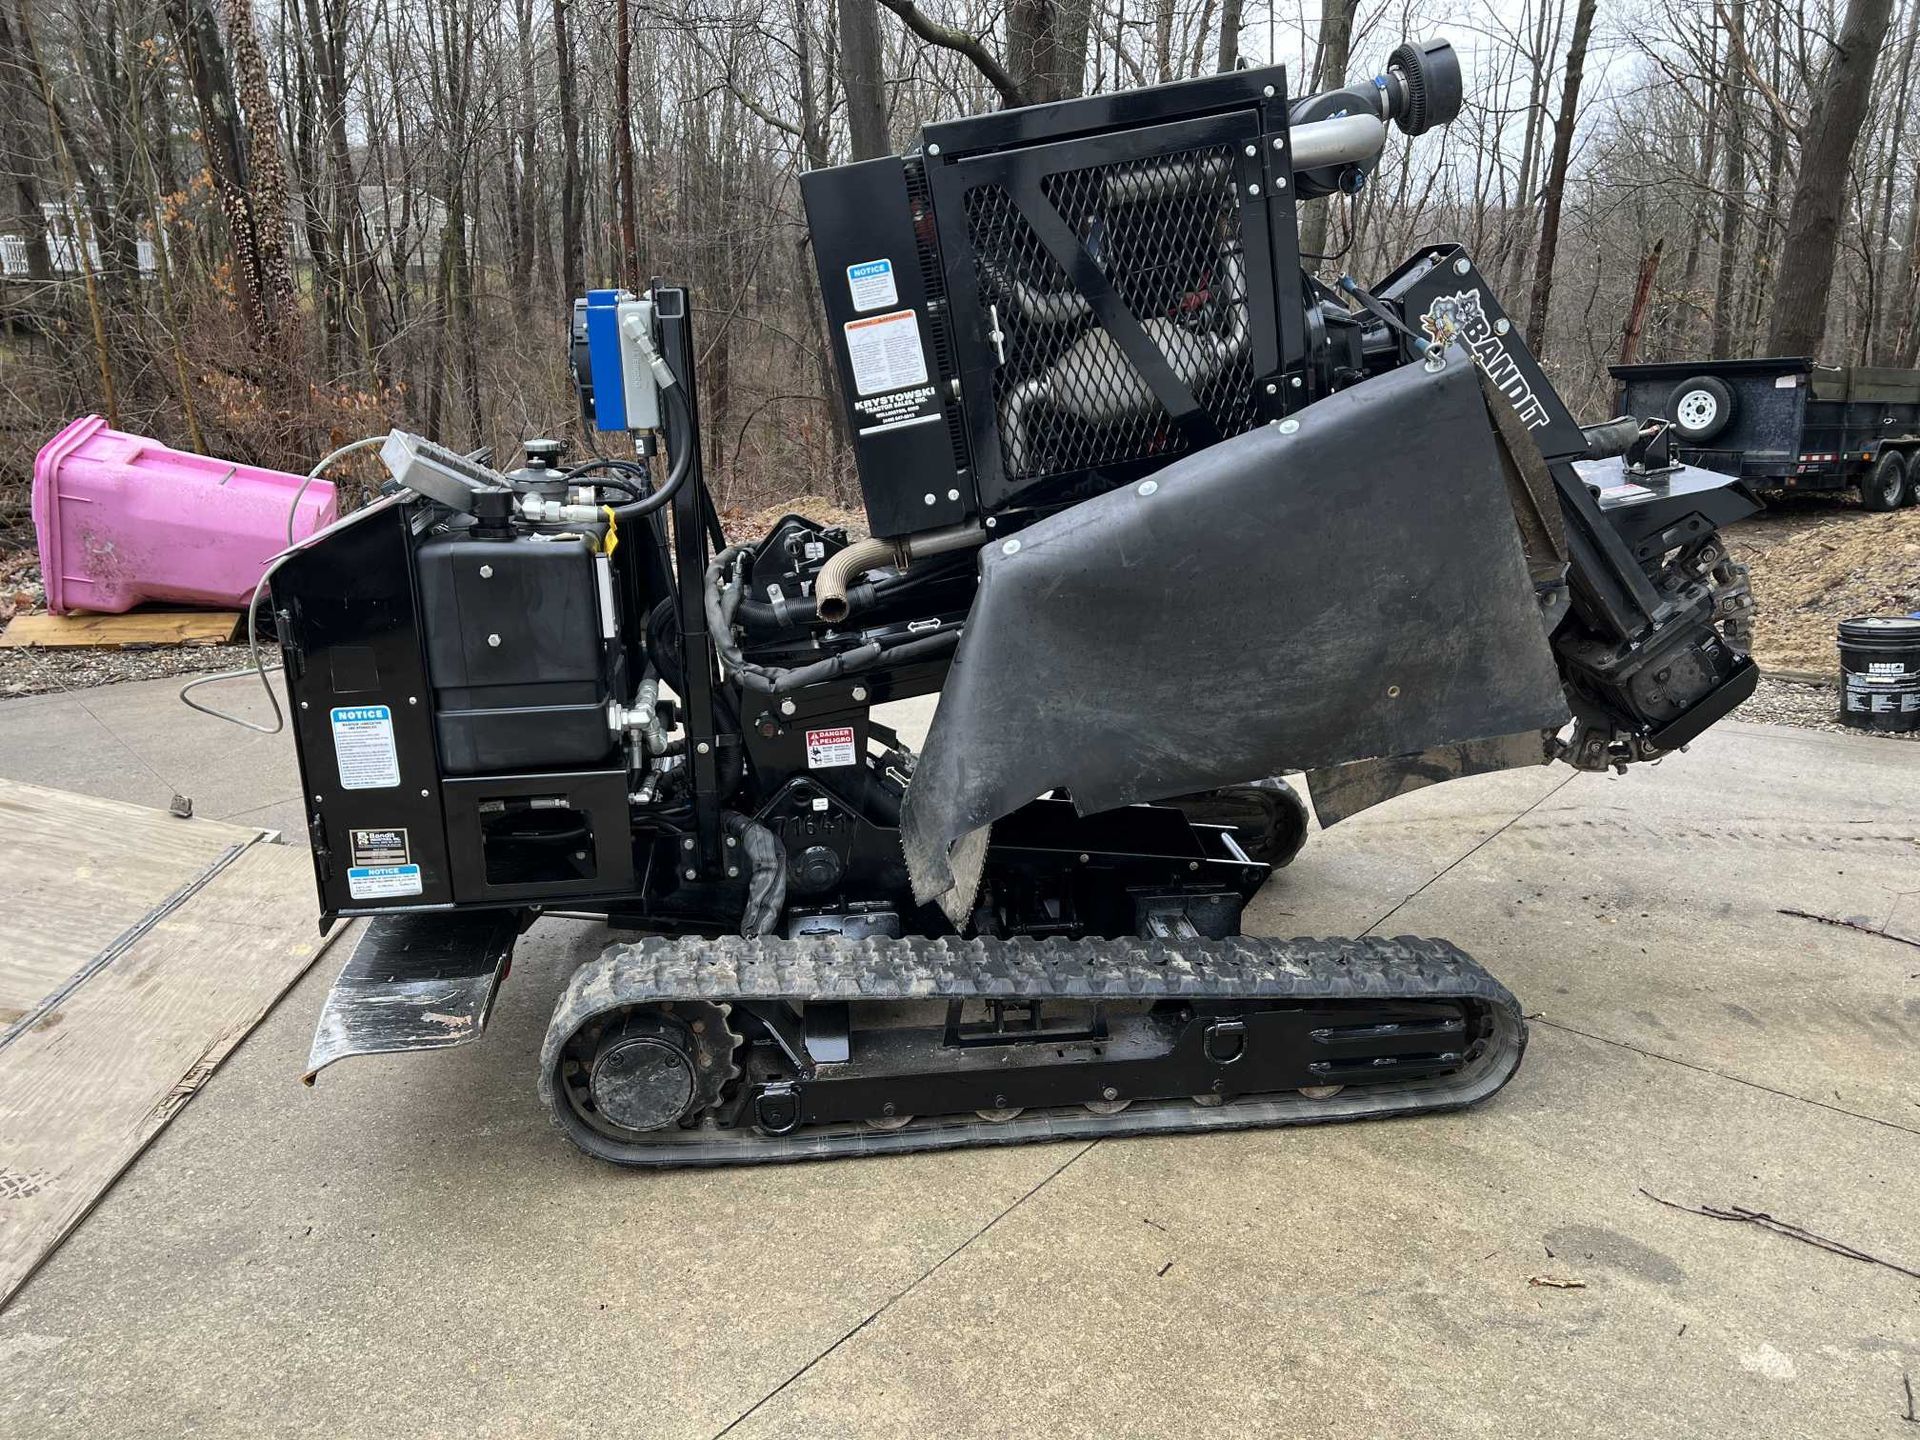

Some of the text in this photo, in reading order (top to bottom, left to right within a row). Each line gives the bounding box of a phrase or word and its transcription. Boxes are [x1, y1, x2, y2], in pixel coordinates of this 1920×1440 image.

[853, 264, 885, 277] NOTICE
[1461, 315, 1550, 431] BANDIT
[854, 387, 936, 411] KRYSTOWSKI
[865, 403, 893, 414] TRACTOR
[337, 709, 383, 720] NOTICE
[819, 730, 850, 738] DANGER
[819, 736, 851, 745] PELIGRO
[367, 867, 400, 876] NOTICE
